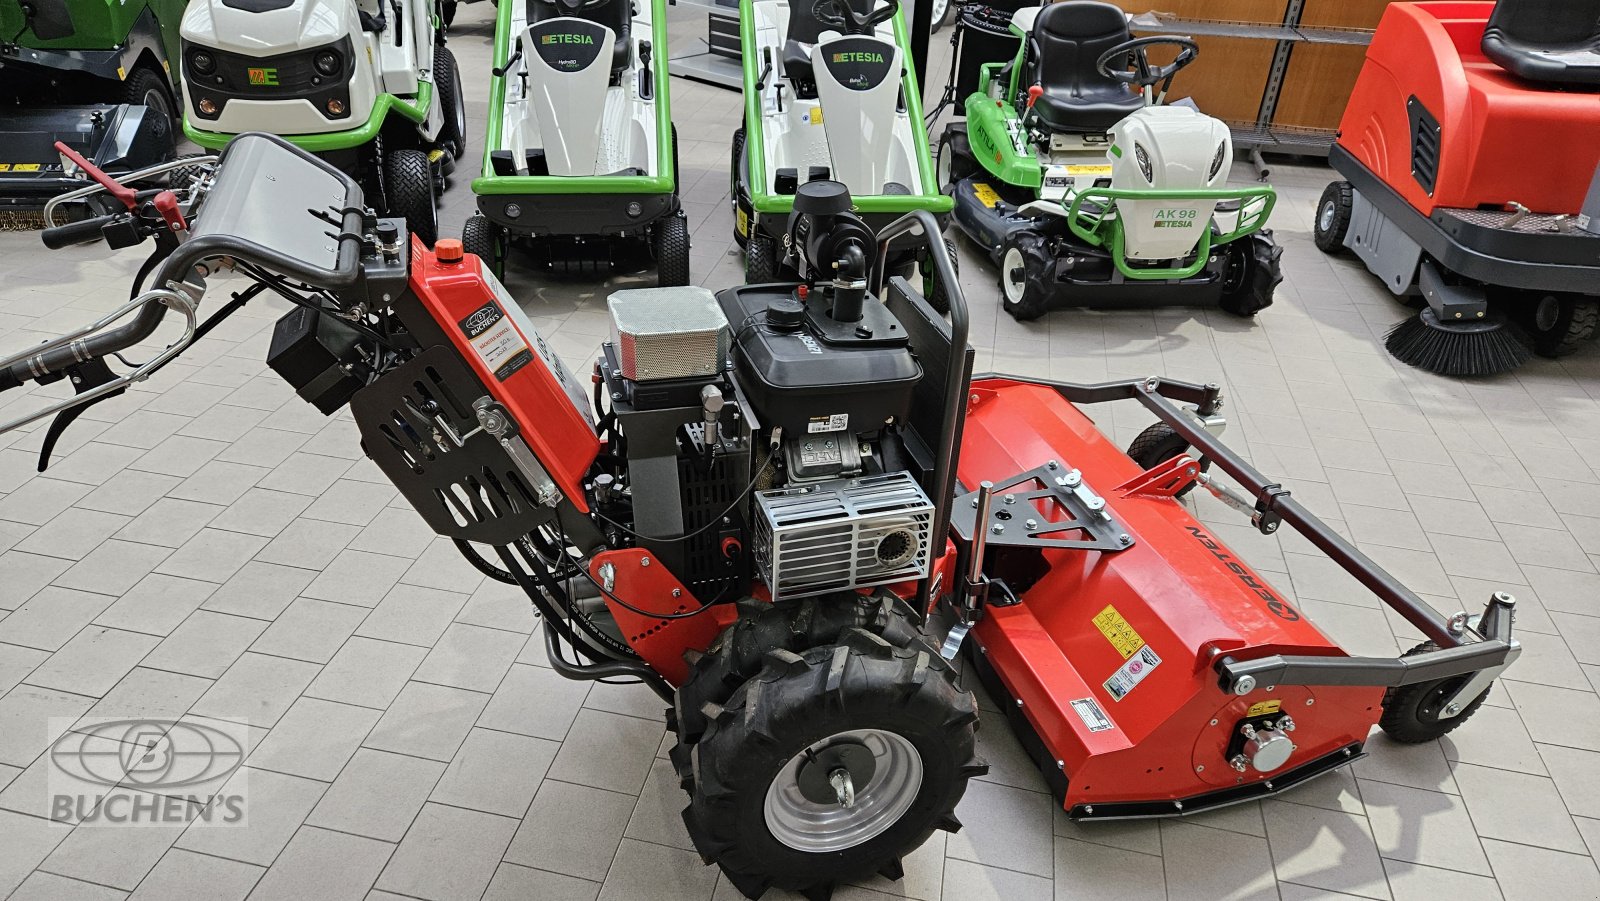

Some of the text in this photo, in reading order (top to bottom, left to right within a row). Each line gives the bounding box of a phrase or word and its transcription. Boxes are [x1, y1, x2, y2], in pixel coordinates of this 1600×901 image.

[549, 33, 594, 45] ETESIA
[840, 51, 884, 63] ETESIA
[976, 125, 995, 155] ATTILA
[1155, 209, 1197, 219] AK 98
[1160, 220, 1193, 228] ETESIA
[470, 313, 501, 336] BUCHEN'S
[804, 450, 837, 462] OHV
[1184, 526, 1299, 622] KERSTEN
